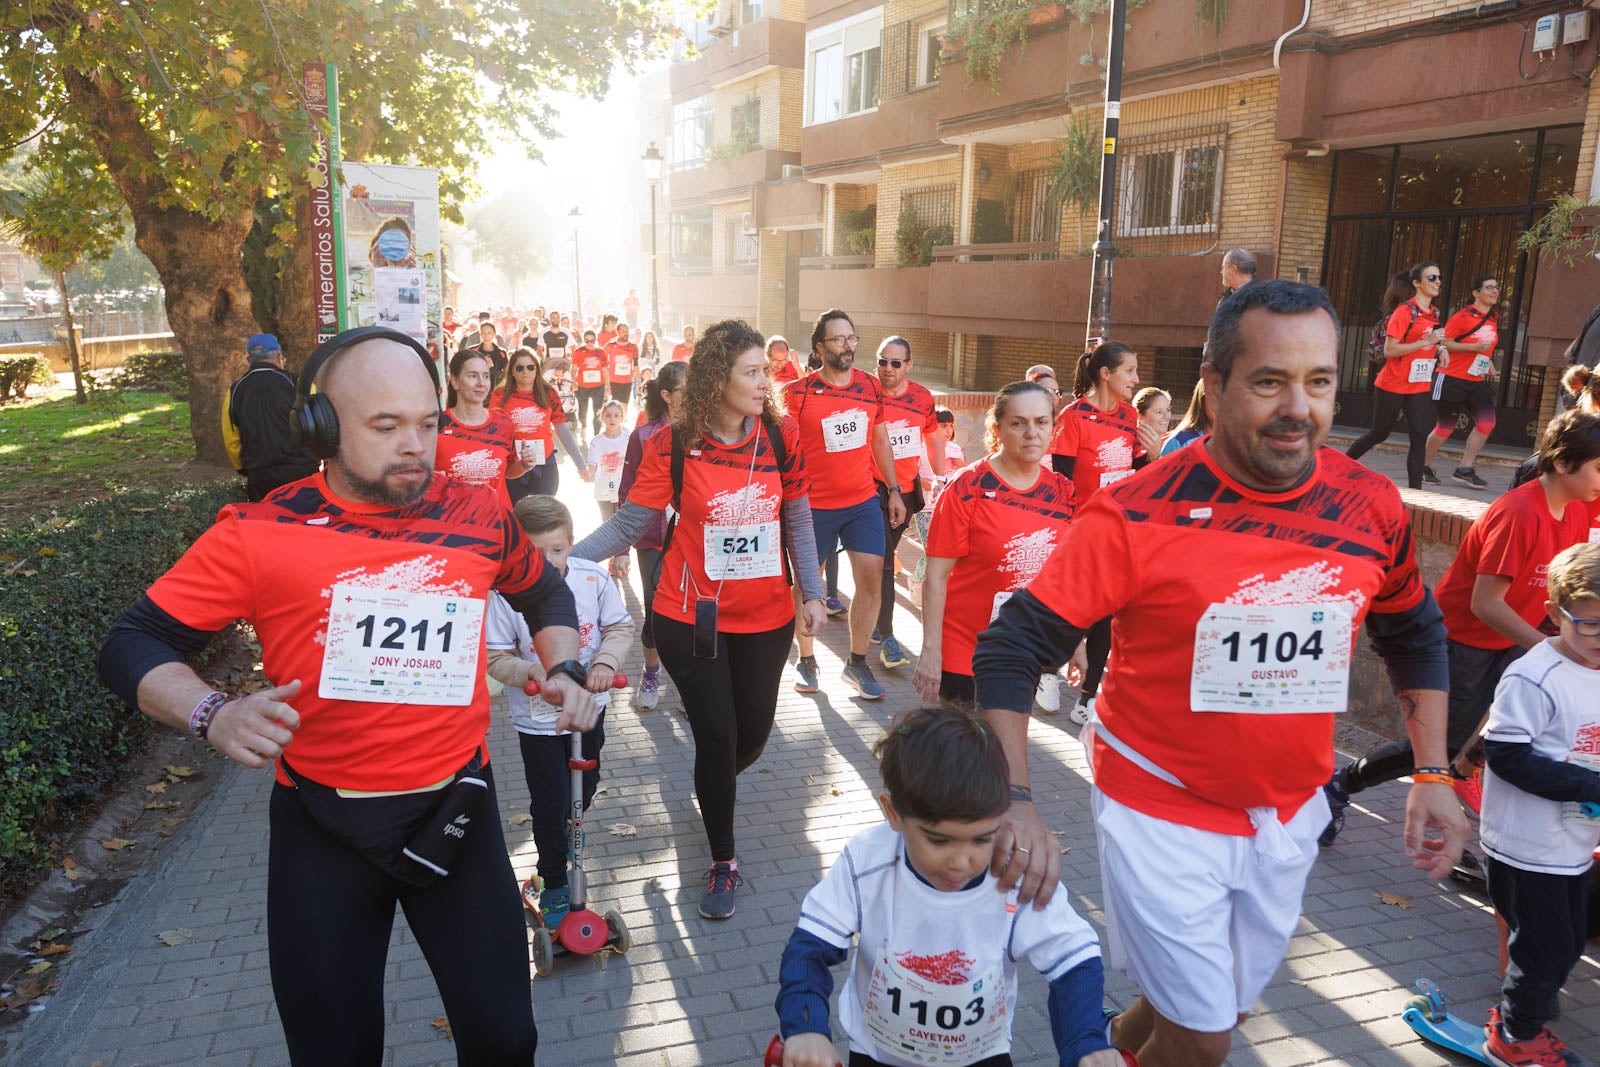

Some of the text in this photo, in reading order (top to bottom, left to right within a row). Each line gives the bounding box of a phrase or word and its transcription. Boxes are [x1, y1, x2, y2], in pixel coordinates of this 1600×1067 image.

[1453, 187, 1463, 205] 2
[1416, 363, 1429, 372] 313
[834, 421, 857, 435] 368
[890, 434, 911, 446] 319
[608, 481, 615, 489] 6
[723, 536, 759, 554] 521
[356, 614, 453, 653] 1211
[1222, 630, 1324, 664] 1104
[371, 656, 443, 670] JONY JOSARO
[1251, 669, 1298, 680] GUSTAVO
[443, 823, 465, 839] ipso
[886, 986, 985, 1030] 1103
[909, 1027, 966, 1044] CAYETANO
